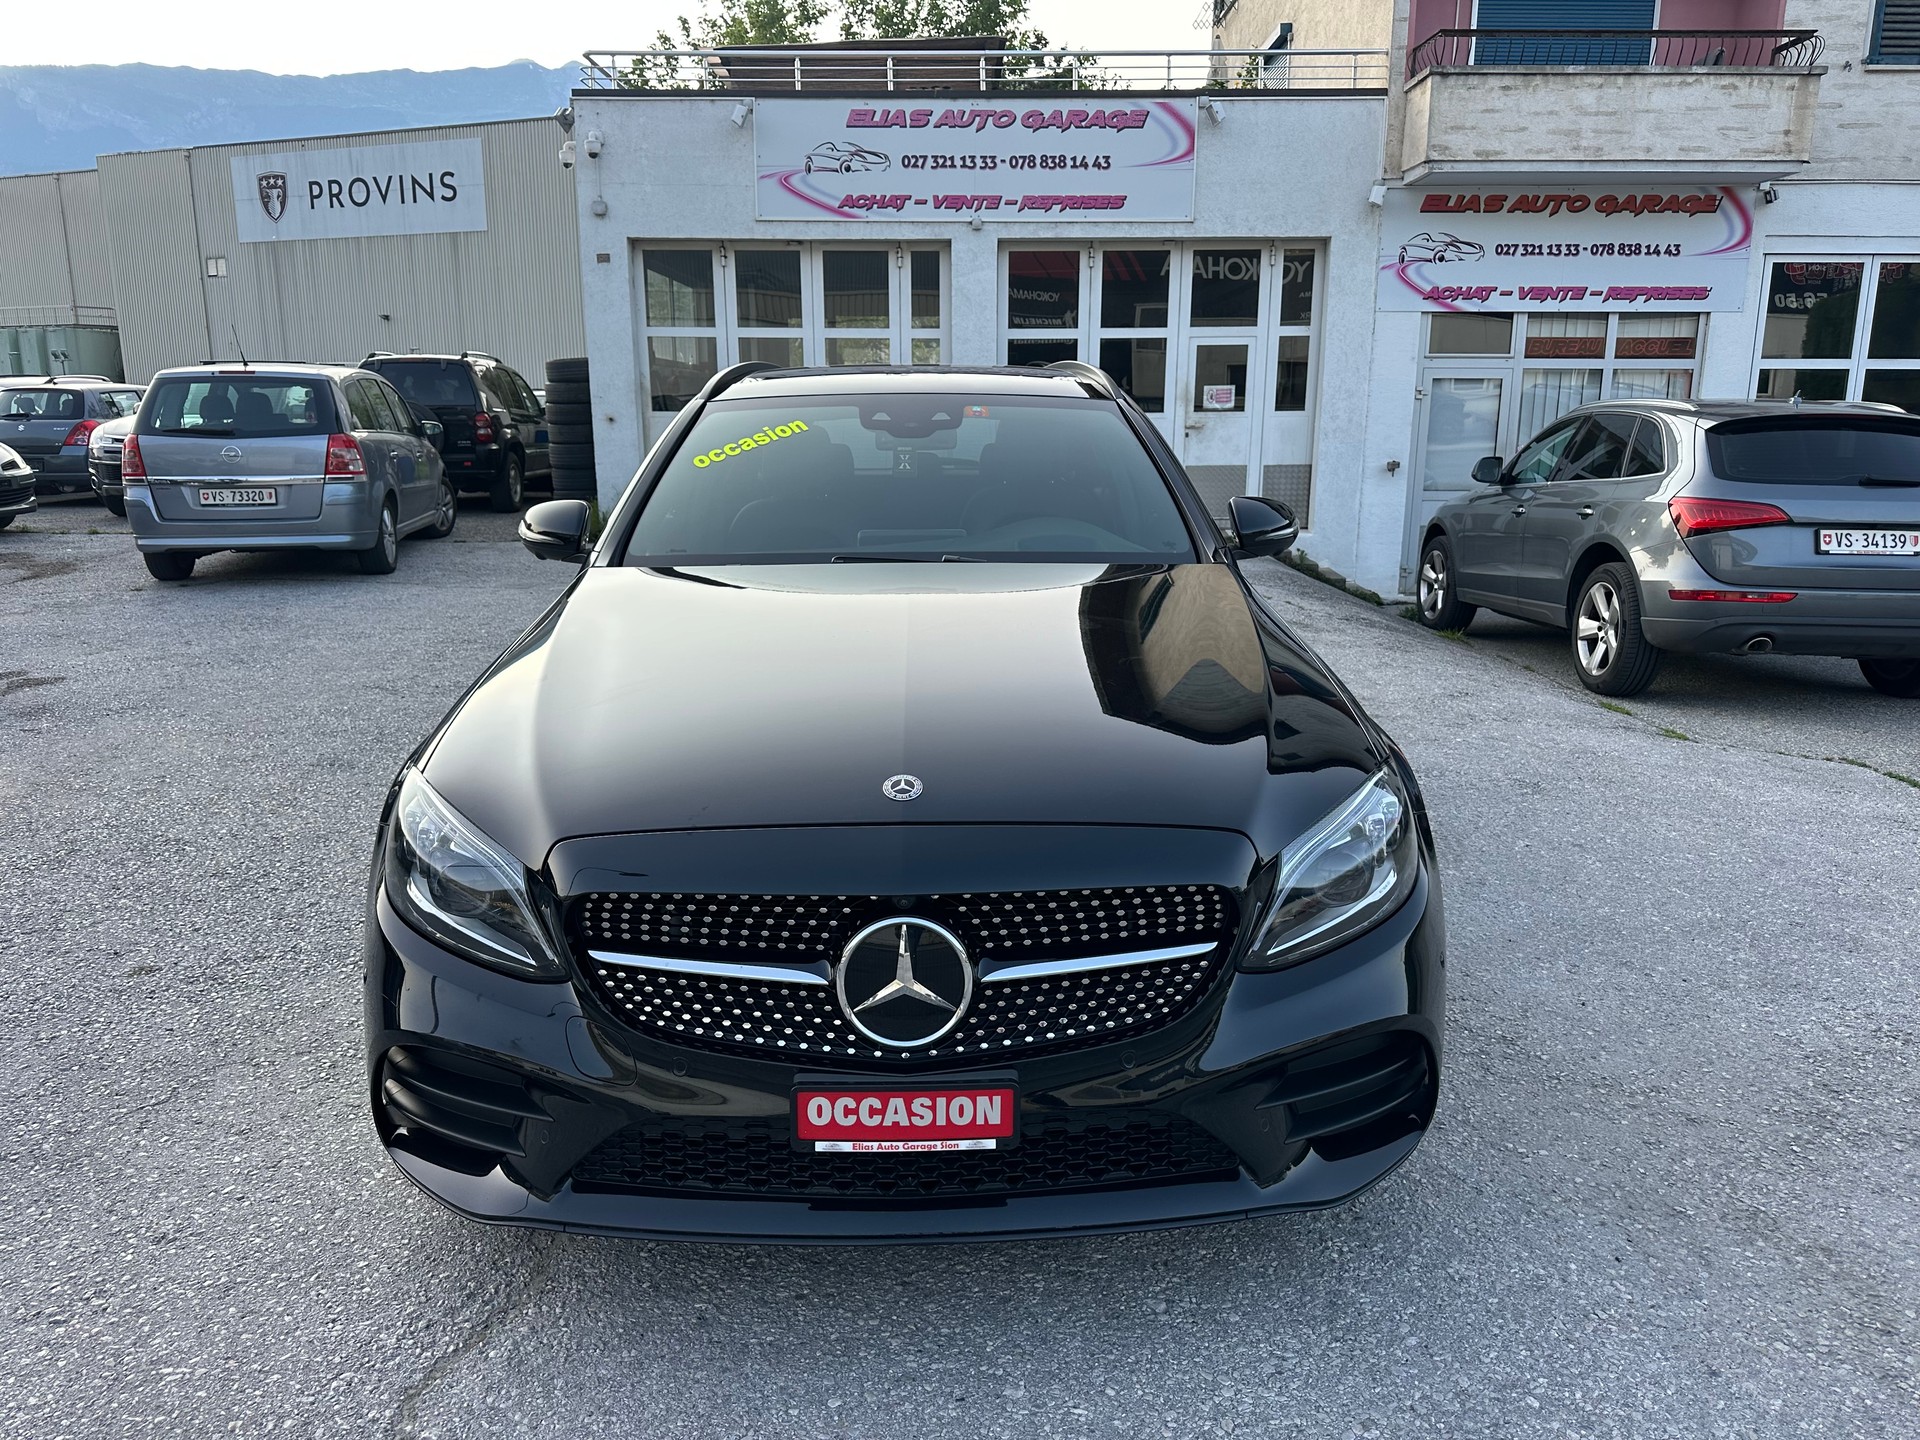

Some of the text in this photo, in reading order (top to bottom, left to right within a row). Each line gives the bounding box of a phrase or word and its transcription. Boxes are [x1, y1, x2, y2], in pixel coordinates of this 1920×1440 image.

[846, 109, 1150, 133] ELIAS AUTO GARAGE
[901, 154, 928, 170] 027
[930, 154, 957, 170] 321
[959, 154, 977, 170] 13
[979, 154, 997, 170] 33
[1009, 154, 1036, 170] 078
[1039, 154, 1067, 170] 838
[1070, 154, 1088, 170] 14
[1092, 154, 1111, 170] 43
[308, 171, 458, 210] PROVINS
[838, 194, 911, 212] ACHAT
[932, 194, 1003, 213] VENTE
[1018, 194, 1127, 213] REPRISES
[1420, 194, 1724, 217] ELIAS AUTO GARAGE
[1495, 243, 1517, 257] 027
[1520, 243, 1543, 257] 321
[1546, 243, 1563, 257] 13
[1564, 243, 1580, 257] 33
[1590, 243, 1614, 257] 078
[1617, 243, 1642, 257] 838
[1644, 243, 1661, 257] 14
[1663, 243, 1681, 257] 43
[1423, 286, 1497, 303] ACHAT
[1518, 286, 1588, 303] VENTE
[1601, 286, 1712, 303] REPRISES
[1528, 338, 1605, 356] BUREAU
[692, 418, 809, 469] occasion
[806, 1095, 1002, 1127] OCCASION
[852, 1142, 874, 1151] Elias
[876, 1142, 900, 1151] Auto
[902, 1142, 938, 1152] Garage
[940, 1141, 959, 1150] Sion
